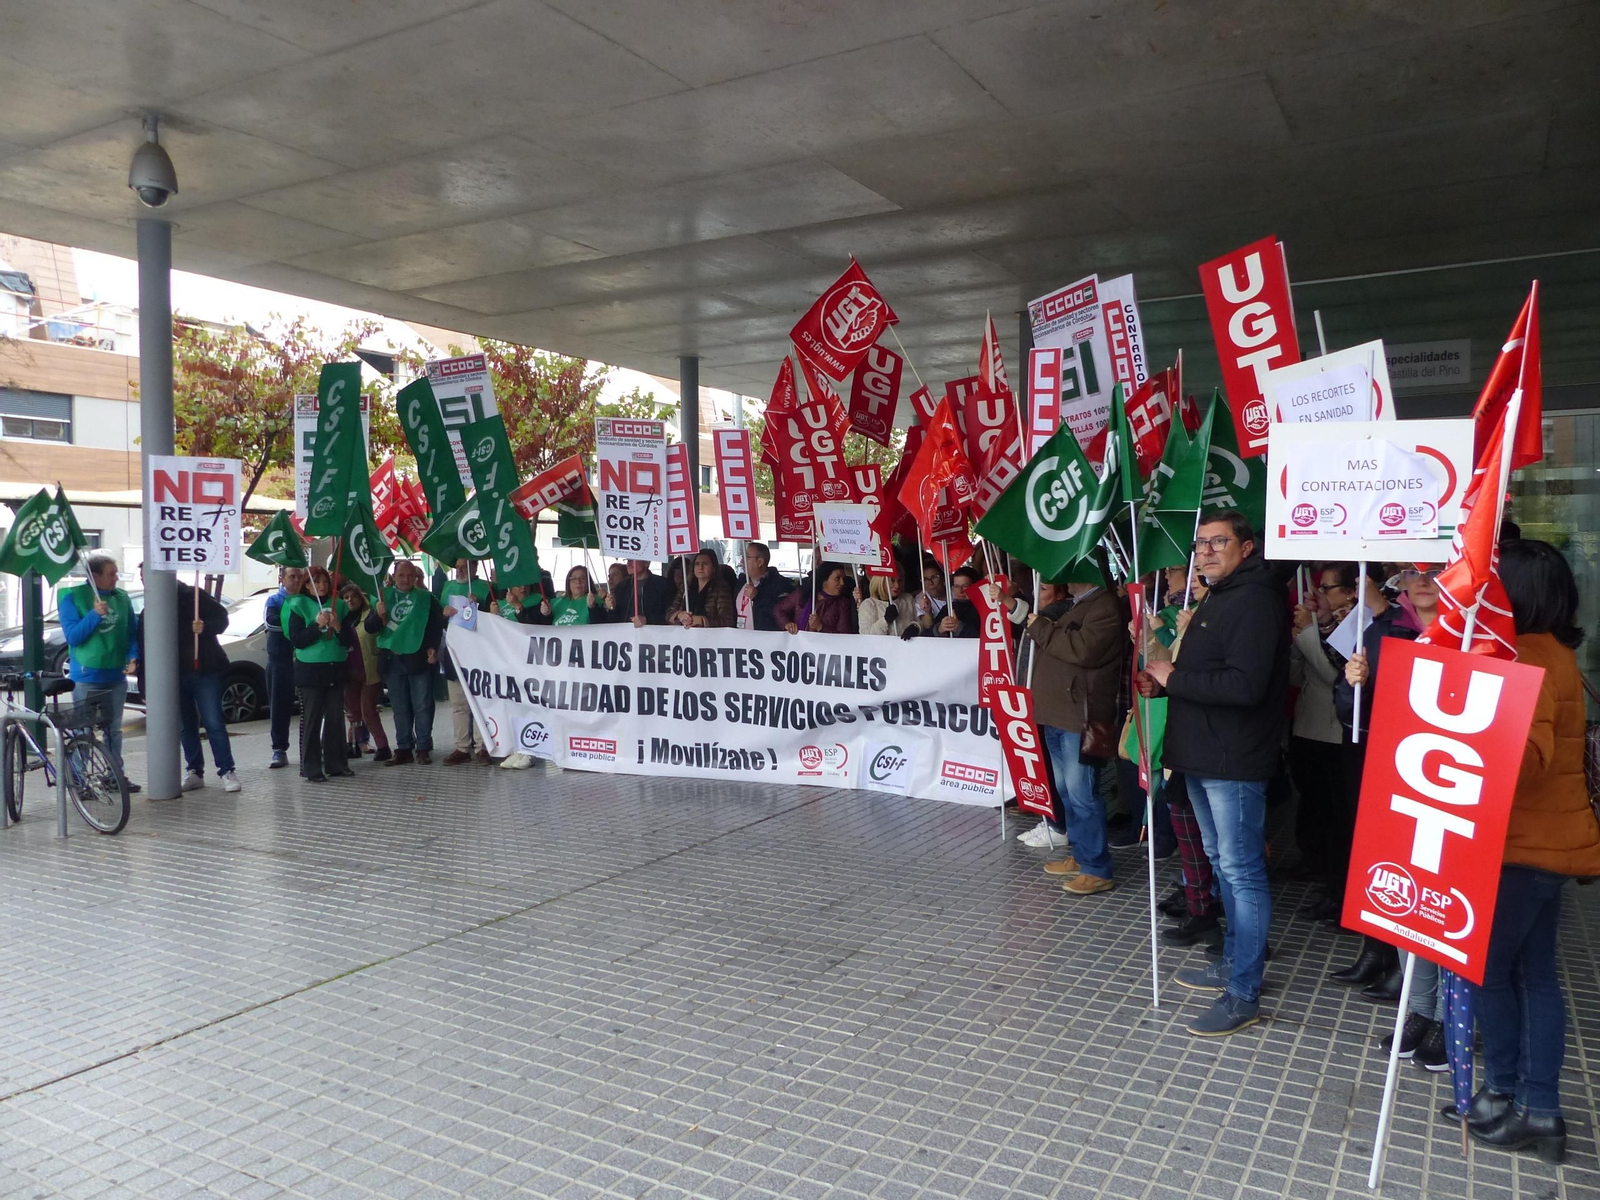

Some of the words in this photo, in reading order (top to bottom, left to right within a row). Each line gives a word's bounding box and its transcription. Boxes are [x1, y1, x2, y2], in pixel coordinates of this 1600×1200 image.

[1046, 290, 1084, 316] CCOO
[826, 286, 871, 339] UGT
[1217, 251, 1282, 395] UGT
[801, 331, 845, 373] www.ugt.es
[1386, 350, 1460, 366] specialidades
[442, 360, 475, 373] CCOO
[1421, 366, 1436, 377] del
[1439, 364, 1460, 376] Pino
[861, 348, 895, 416] UGT
[1291, 396, 1309, 407] LOS
[1311, 383, 1355, 403] RECORTES
[1314, 405, 1354, 422] SANIDAD
[615, 424, 652, 435] CCOO
[801, 404, 838, 478] UGT
[1347, 459, 1378, 470] MAS
[600, 459, 661, 495] NO
[719, 432, 752, 537] CCOO
[1301, 478, 1423, 491] CONTRATACIONES
[153, 469, 234, 506] NO
[1039, 458, 1084, 523] CSIF
[606, 494, 629, 510] RE
[161, 506, 192, 521] RE
[1295, 507, 1314, 517] UGT
[1383, 506, 1402, 516] UGT
[606, 514, 645, 531] COR
[160, 526, 212, 543] COR
[466, 520, 487, 544] CSI
[606, 534, 642, 551] TES
[160, 547, 207, 562] TES
[526, 636, 562, 666] NO
[567, 638, 585, 669] A
[591, 640, 632, 672] LOS
[638, 643, 765, 680] RECORTES
[771, 650, 887, 692] SOCIALES
[495, 674, 521, 703] LA
[523, 677, 630, 714] CALIDAD
[637, 686, 669, 717] DE
[673, 689, 718, 721] LOS
[725, 691, 857, 730] SERVICIOS
[998, 690, 1040, 779] UGT
[572, 740, 605, 751] CCOO
[651, 737, 765, 771] Movilízate
[571, 751, 588, 759] área
[589, 752, 616, 762] pública
[944, 765, 983, 783] CCOO
[1390, 657, 1504, 874] UGT
[940, 778, 960, 789] área
[962, 782, 995, 795] pública
[1371, 867, 1412, 900] UGT
[1420, 887, 1452, 909] FSP
[1419, 910, 1445, 925] Públicos
[1420, 904, 1446, 918] Servicios
